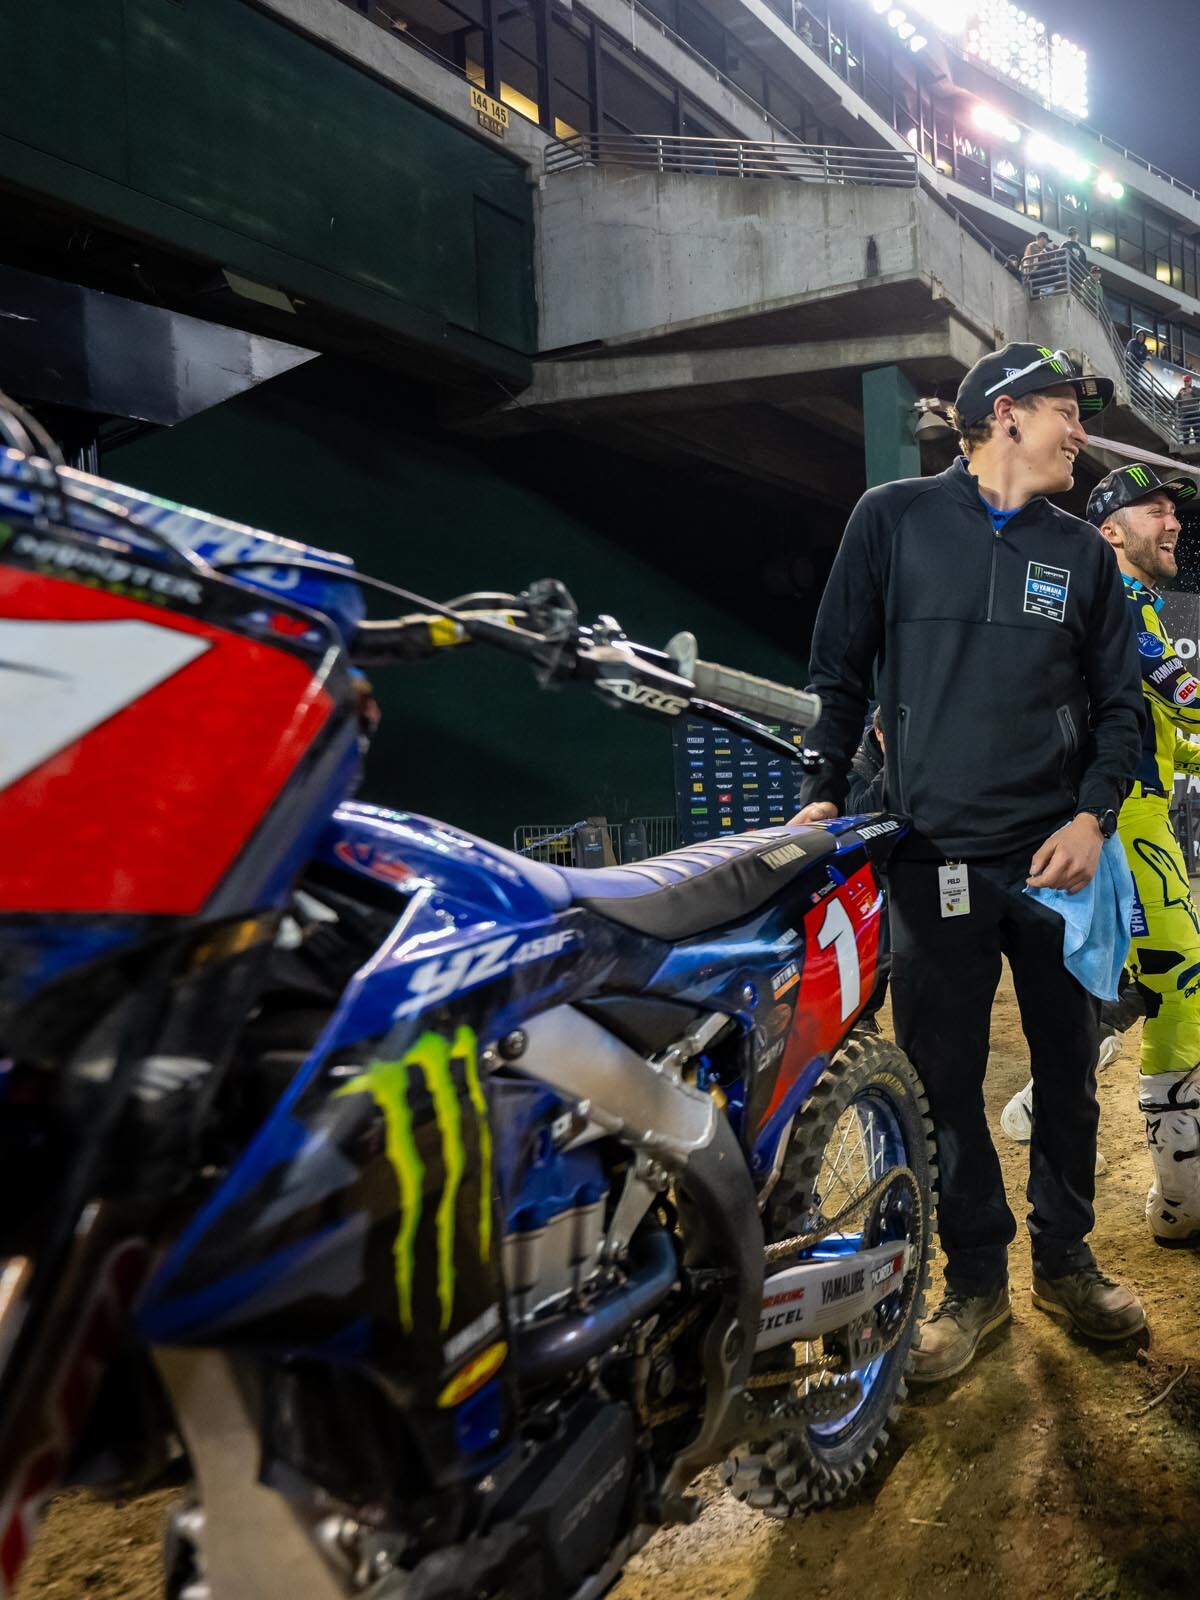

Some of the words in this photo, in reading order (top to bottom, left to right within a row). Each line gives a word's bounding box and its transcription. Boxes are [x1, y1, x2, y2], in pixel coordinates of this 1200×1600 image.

[473, 91, 488, 111] 144
[491, 103, 507, 123] 145
[1039, 584, 1062, 596] YAMAHA
[856, 820, 900, 840] DUNLOP
[817, 897, 861, 1025] 1
[821, 1269, 865, 1305] YAMALUBE
